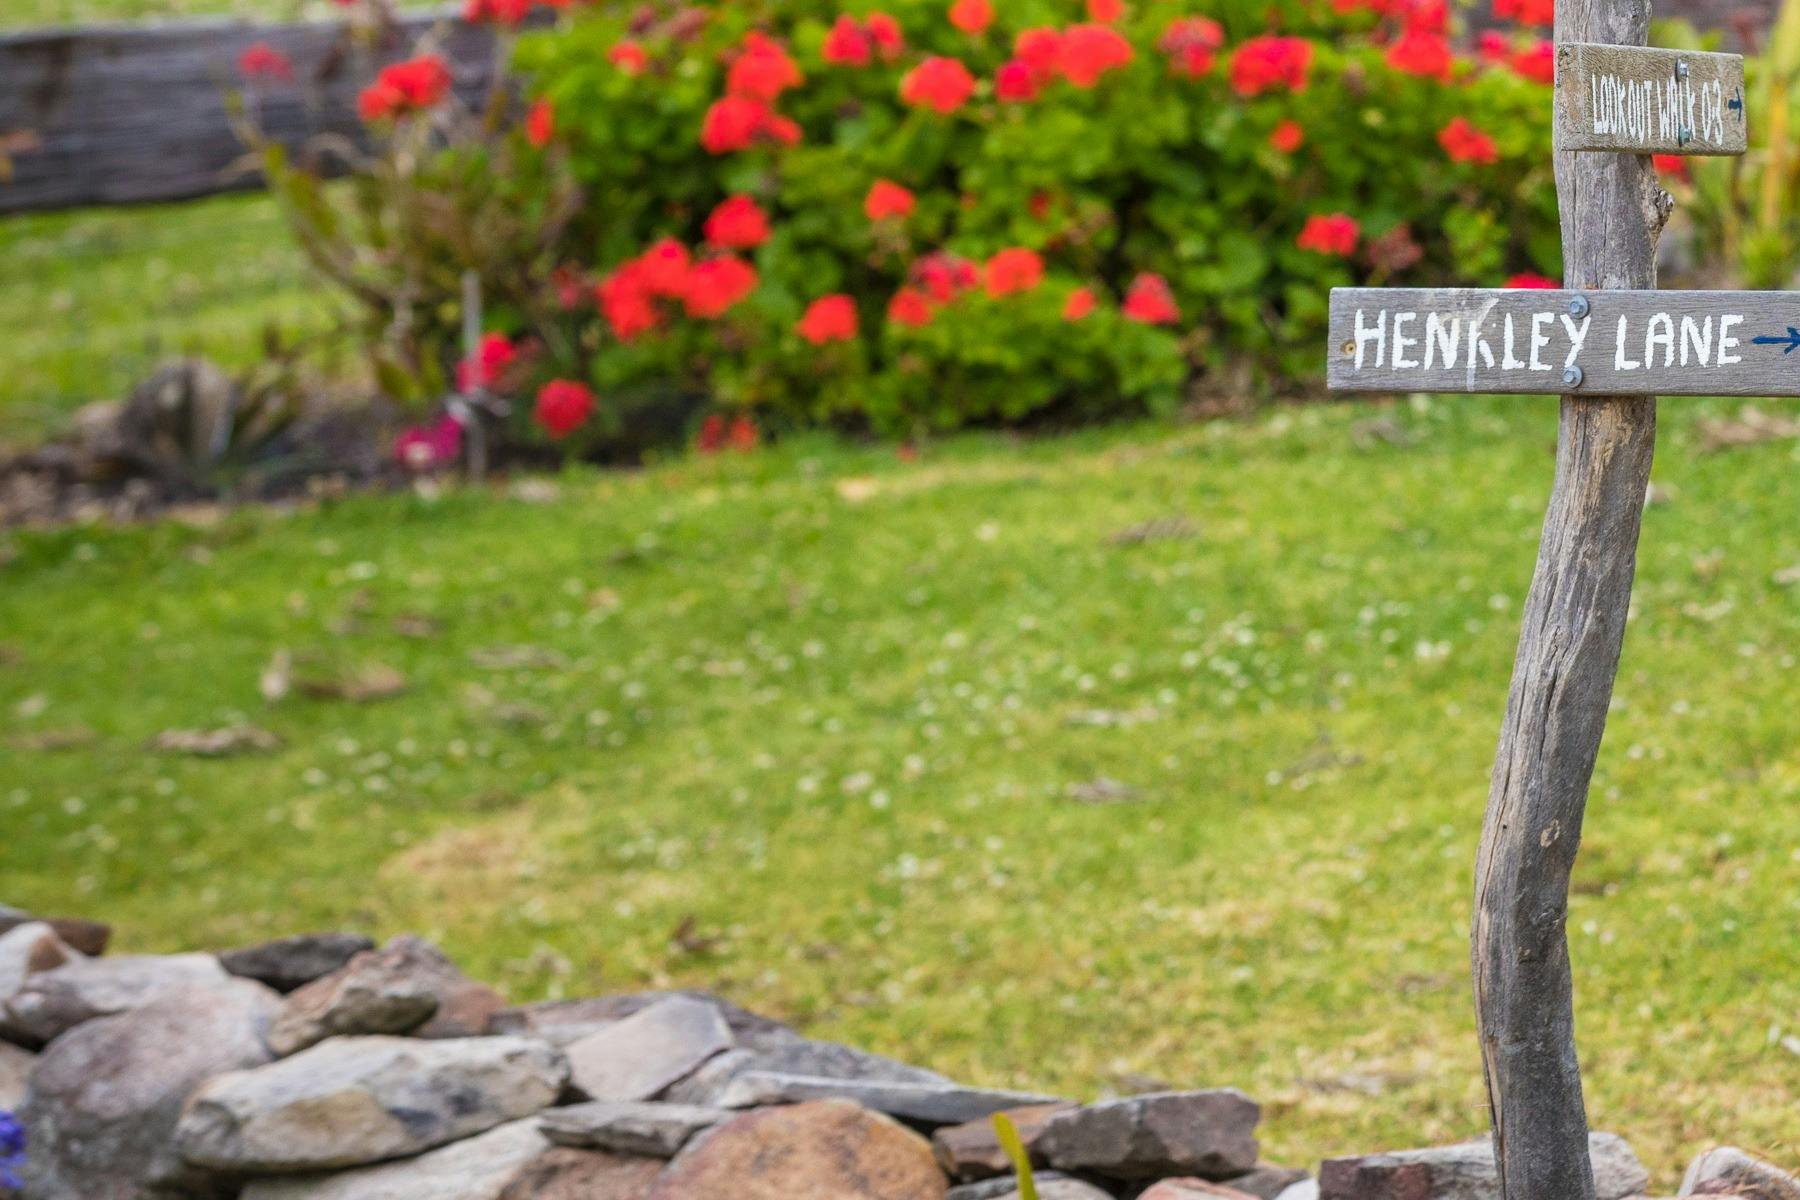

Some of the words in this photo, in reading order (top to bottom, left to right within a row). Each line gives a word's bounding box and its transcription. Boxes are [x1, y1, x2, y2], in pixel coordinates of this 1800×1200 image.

[1656, 70, 1697, 143] WALK
[1354, 299, 1592, 372] HENKLEY
[1614, 312, 1745, 371] LANE
